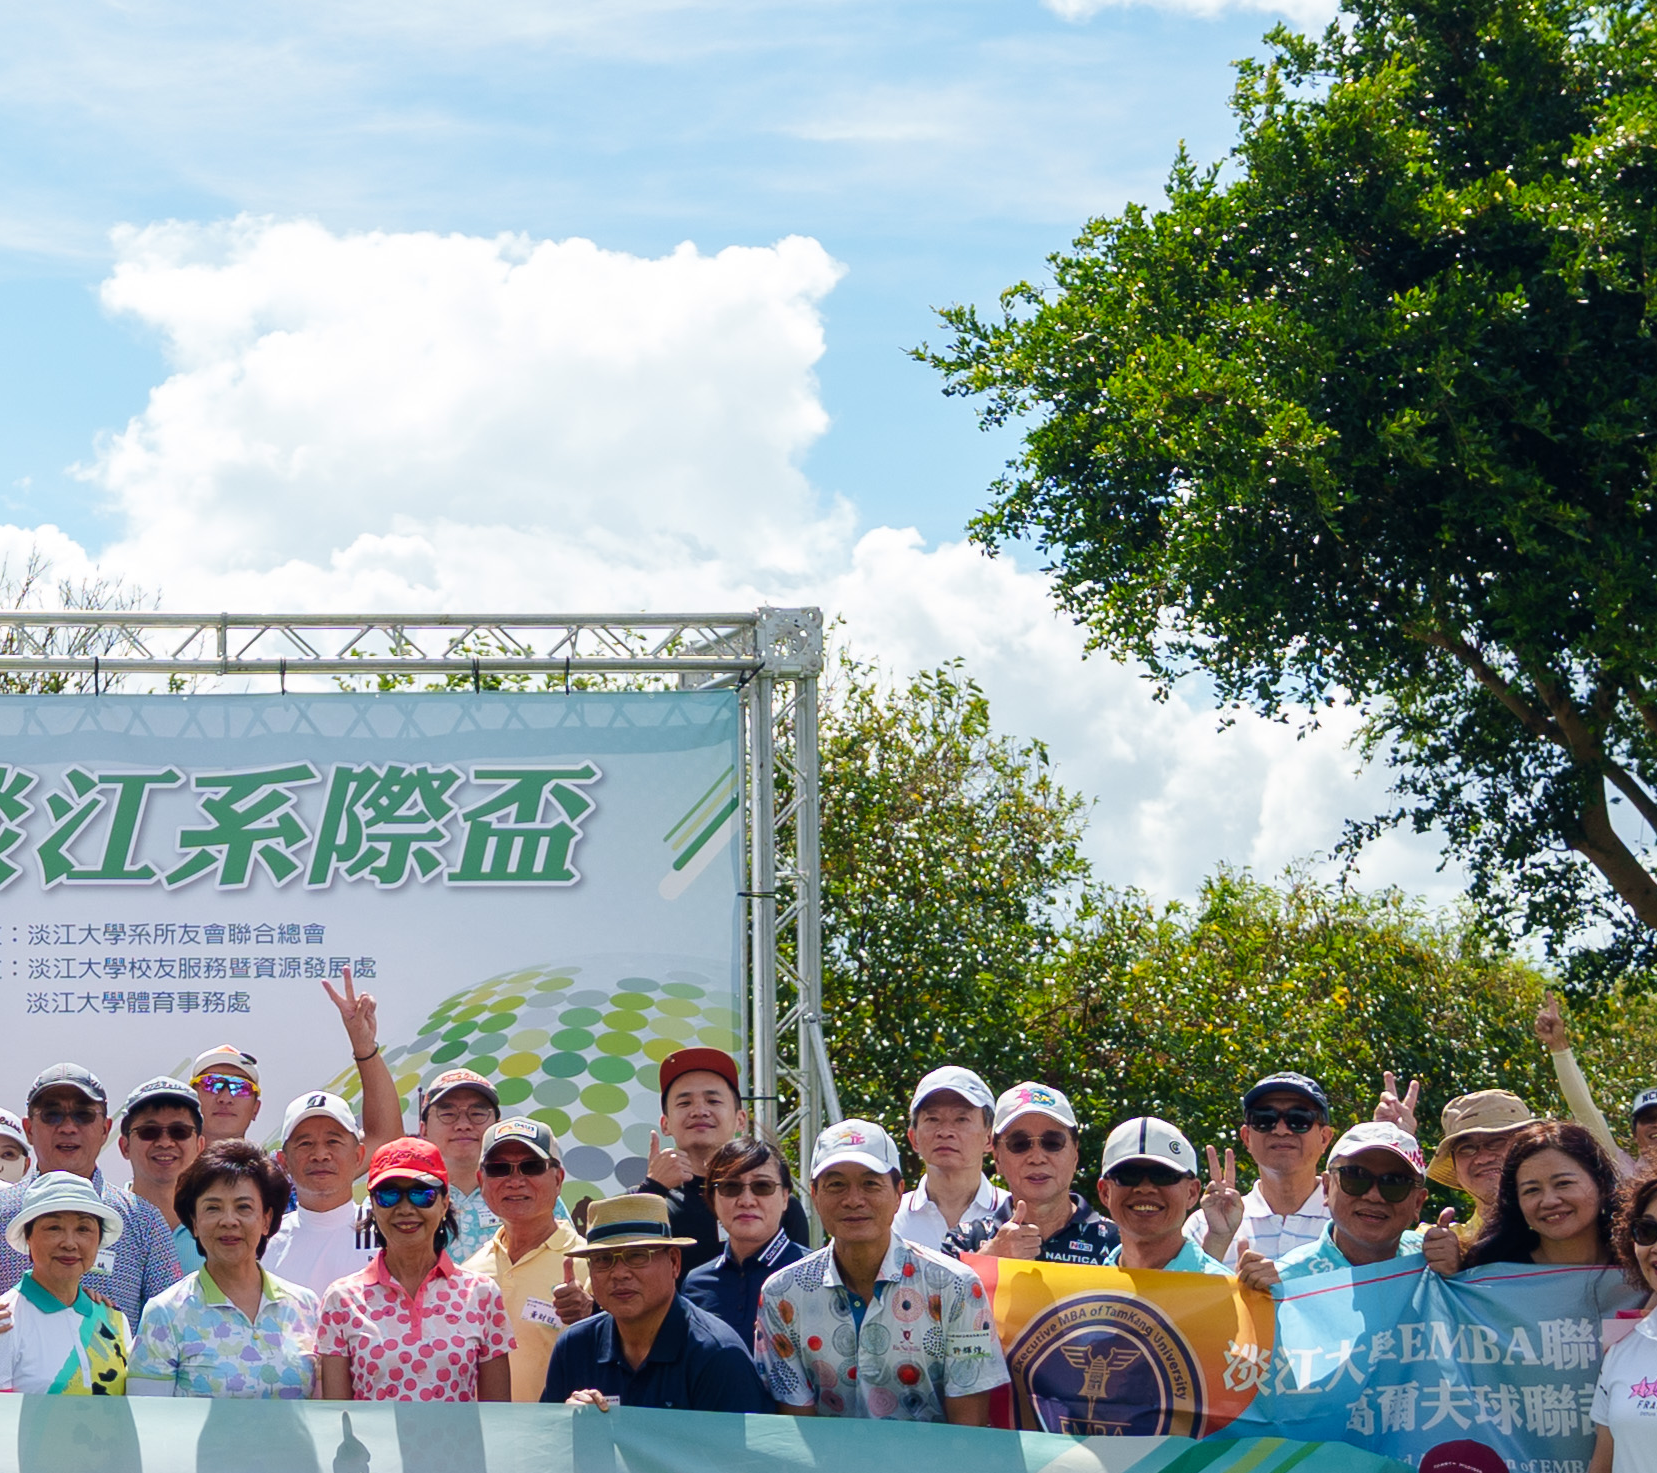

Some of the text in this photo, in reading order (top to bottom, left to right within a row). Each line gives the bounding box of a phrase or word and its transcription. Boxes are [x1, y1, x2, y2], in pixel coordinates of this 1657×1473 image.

[26, 990, 250, 1014] 淡江大學體育事務處
[1045, 1251, 1099, 1266] NAUTICA
[1014, 1305, 1187, 1401] Executive MBA of TamKang University
[1222, 1318, 1601, 1396] 淡江大學EMBA聯
[1520, 1459, 1538, 1473] of
